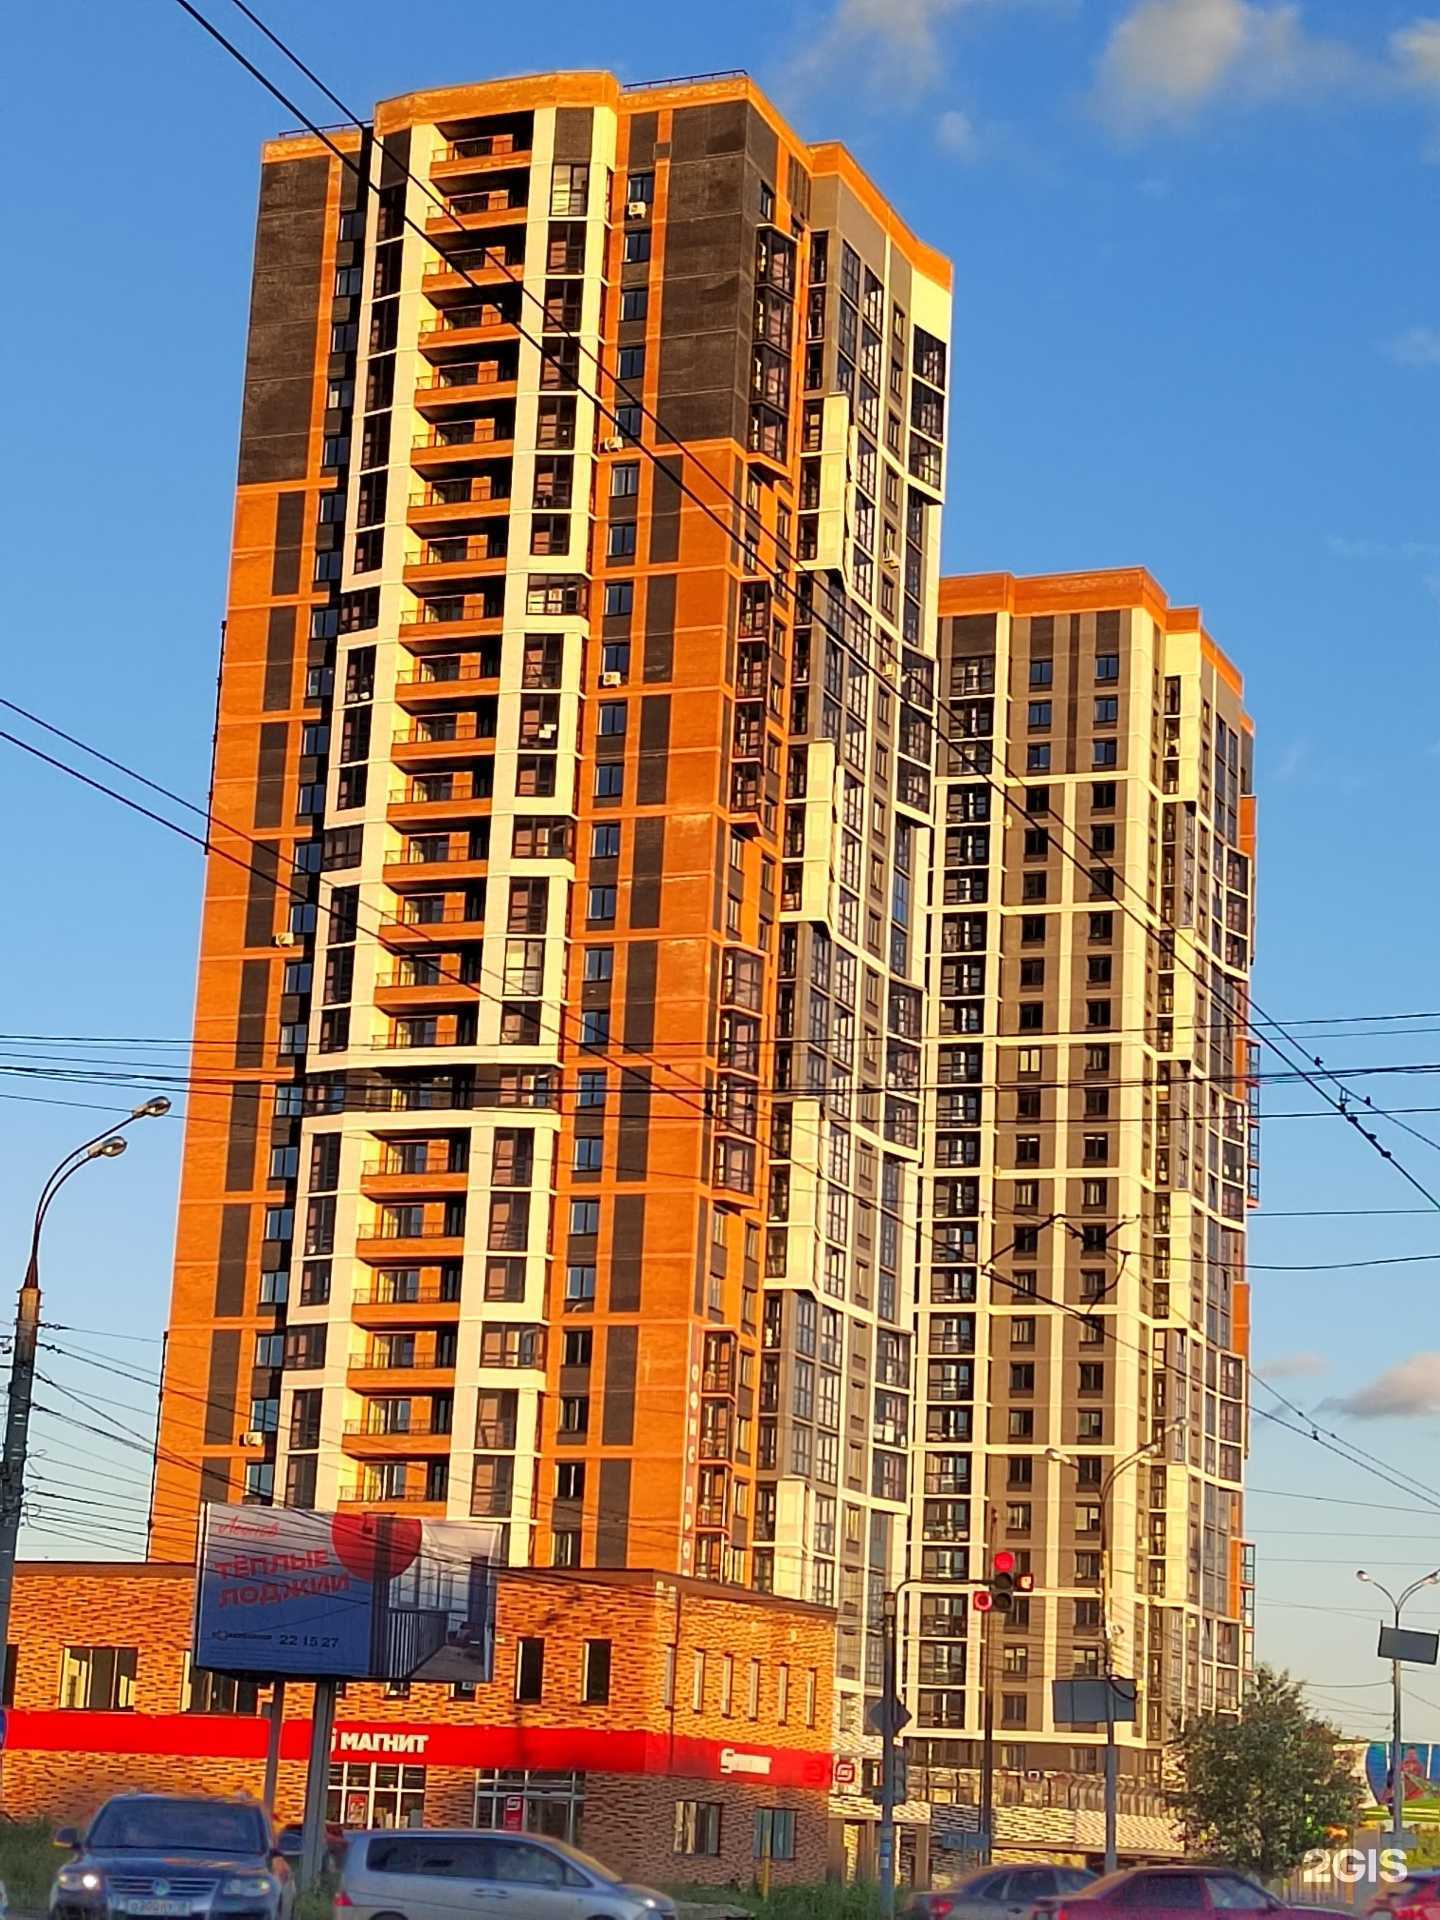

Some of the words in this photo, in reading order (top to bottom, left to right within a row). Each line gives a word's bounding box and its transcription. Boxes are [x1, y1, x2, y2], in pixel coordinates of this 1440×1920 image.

[219, 1575, 350, 1607] ЛОДЖИИ
[279, 1634, 298, 1646] 22
[304, 1635, 318, 1647] 15
[320, 1636, 339, 1648] 27
[340, 1732, 429, 1753] МАГНИТ
